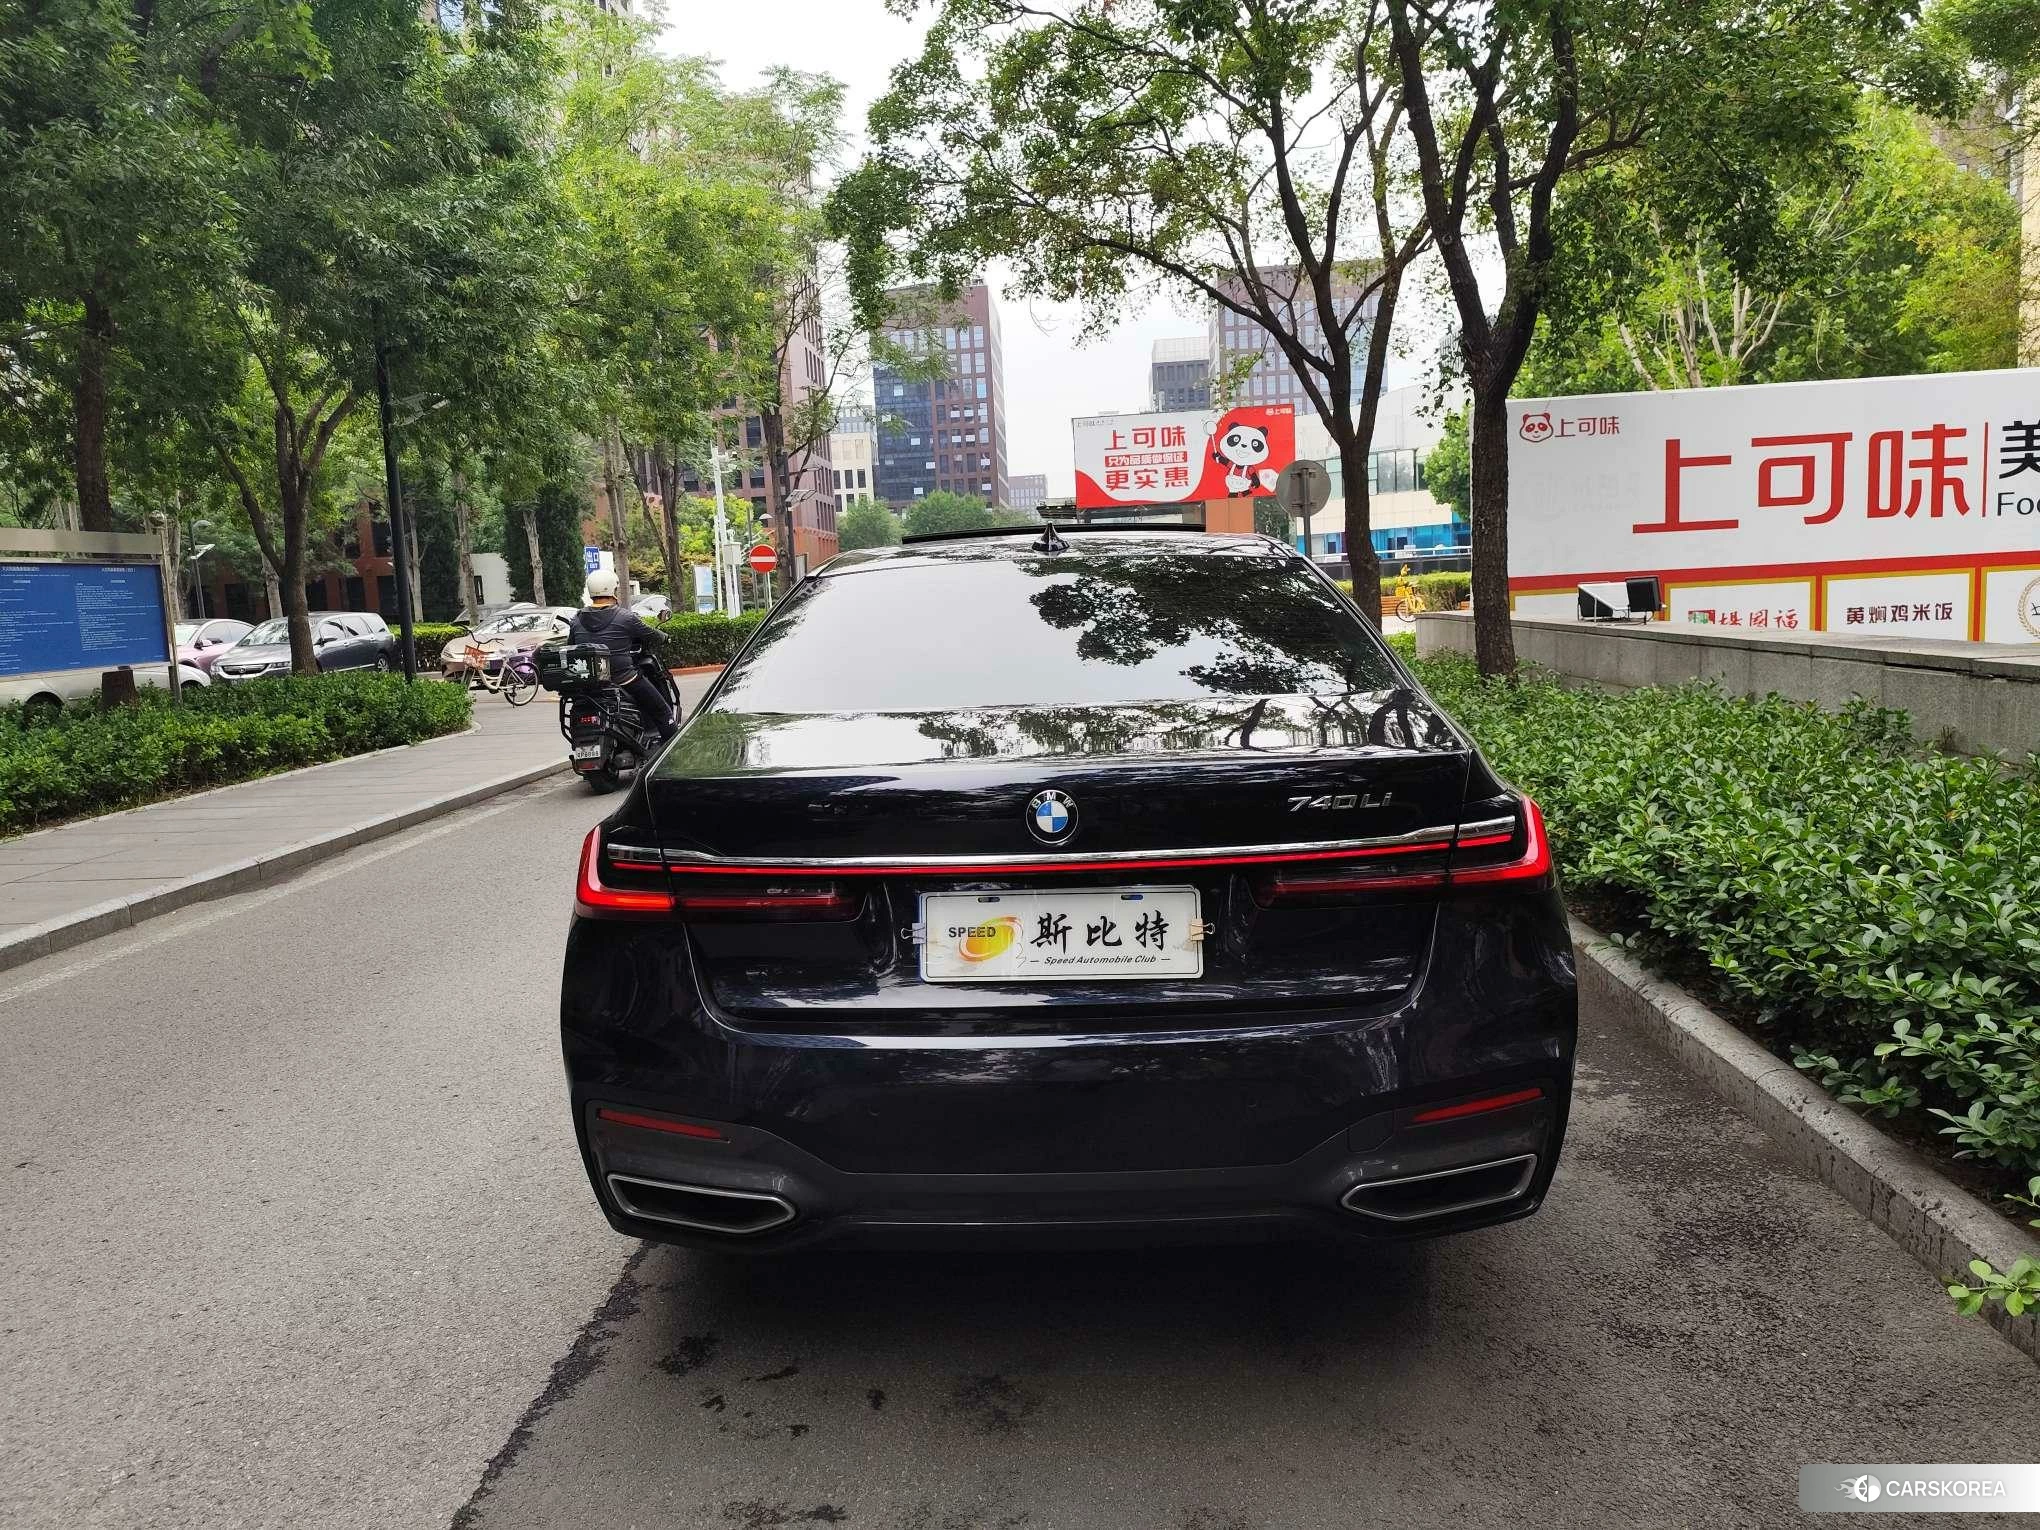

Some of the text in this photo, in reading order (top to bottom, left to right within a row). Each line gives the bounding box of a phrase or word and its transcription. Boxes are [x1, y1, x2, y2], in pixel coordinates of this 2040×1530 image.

[1104, 425, 1187, 451] 上可味
[1554, 416, 1621, 438] 上可味
[1107, 452, 1185, 467] 只为品质做保证
[1105, 466, 1189, 491] 更实惠
[1632, 422, 1971, 534] 上可味
[1996, 491, 2040, 516] Fo
[1846, 600, 1955, 625] 黄焖鸡米饭
[1031, 791, 1074, 810] BMW
[948, 926, 996, 938] SPEED
[1029, 910, 1171, 954] 斯比特
[1044, 955, 1157, 965] Speed Automobile Club
